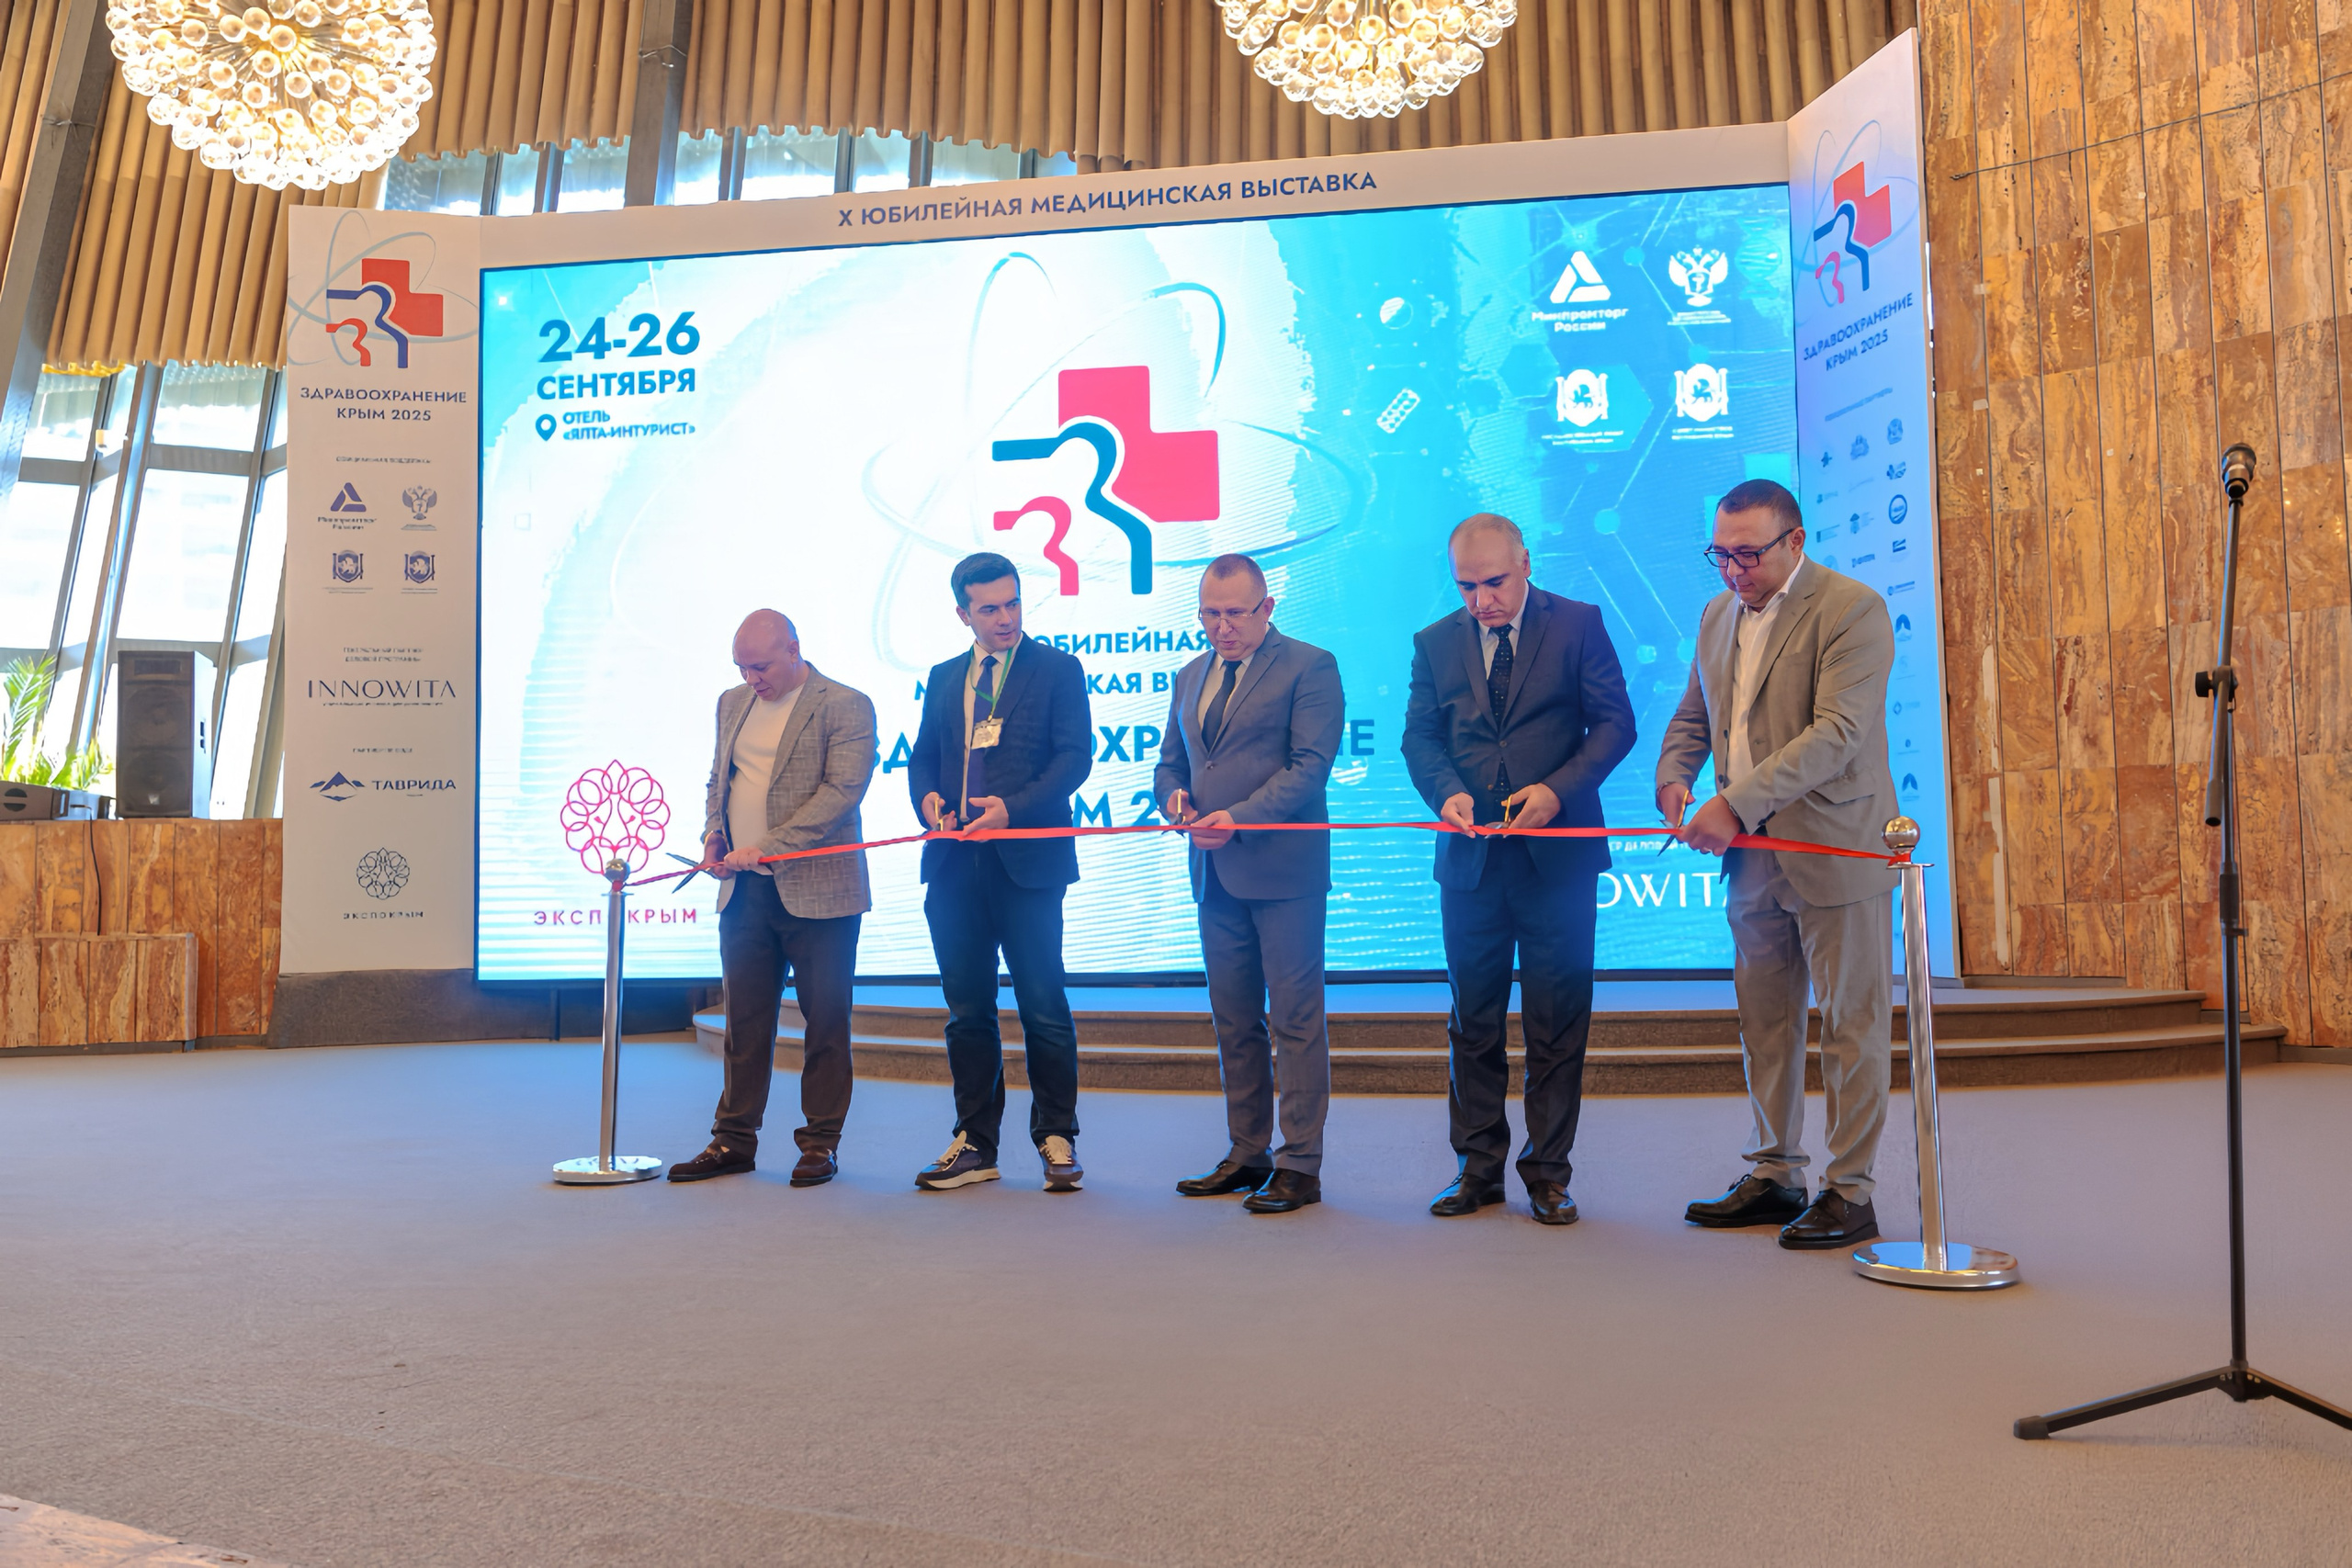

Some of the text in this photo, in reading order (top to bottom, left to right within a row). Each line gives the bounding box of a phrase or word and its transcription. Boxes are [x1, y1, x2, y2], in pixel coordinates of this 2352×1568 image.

[861, 197, 1023, 225] ЮБИЛЕЙНАЯ
[1031, 182, 1232, 214] МЕДИЦИНСКАЯ
[1241, 171, 1377, 198] ВЫСТАВКА
[1531, 308, 1630, 321] Минпромторг
[1554, 321, 1607, 333] России
[1803, 291, 1914, 361] ЗДРАВООХРАНЕНИЕ
[537, 310, 701, 363] 24-26
[1826, 328, 1889, 371] КРЫМ 2025
[537, 367, 696, 400] СЕНТЯБРЯ
[300, 387, 468, 403] ЗДРАВООХРАНЕНИЕ
[336, 407, 432, 422] КРЫМ 2025
[562, 409, 611, 425] ОТЕЛЬ
[308, 679, 457, 699] INNOWITA
[370, 779, 457, 791] ТАВРИДА
[533, 908, 697, 926] ЭКСПКРЫМ
